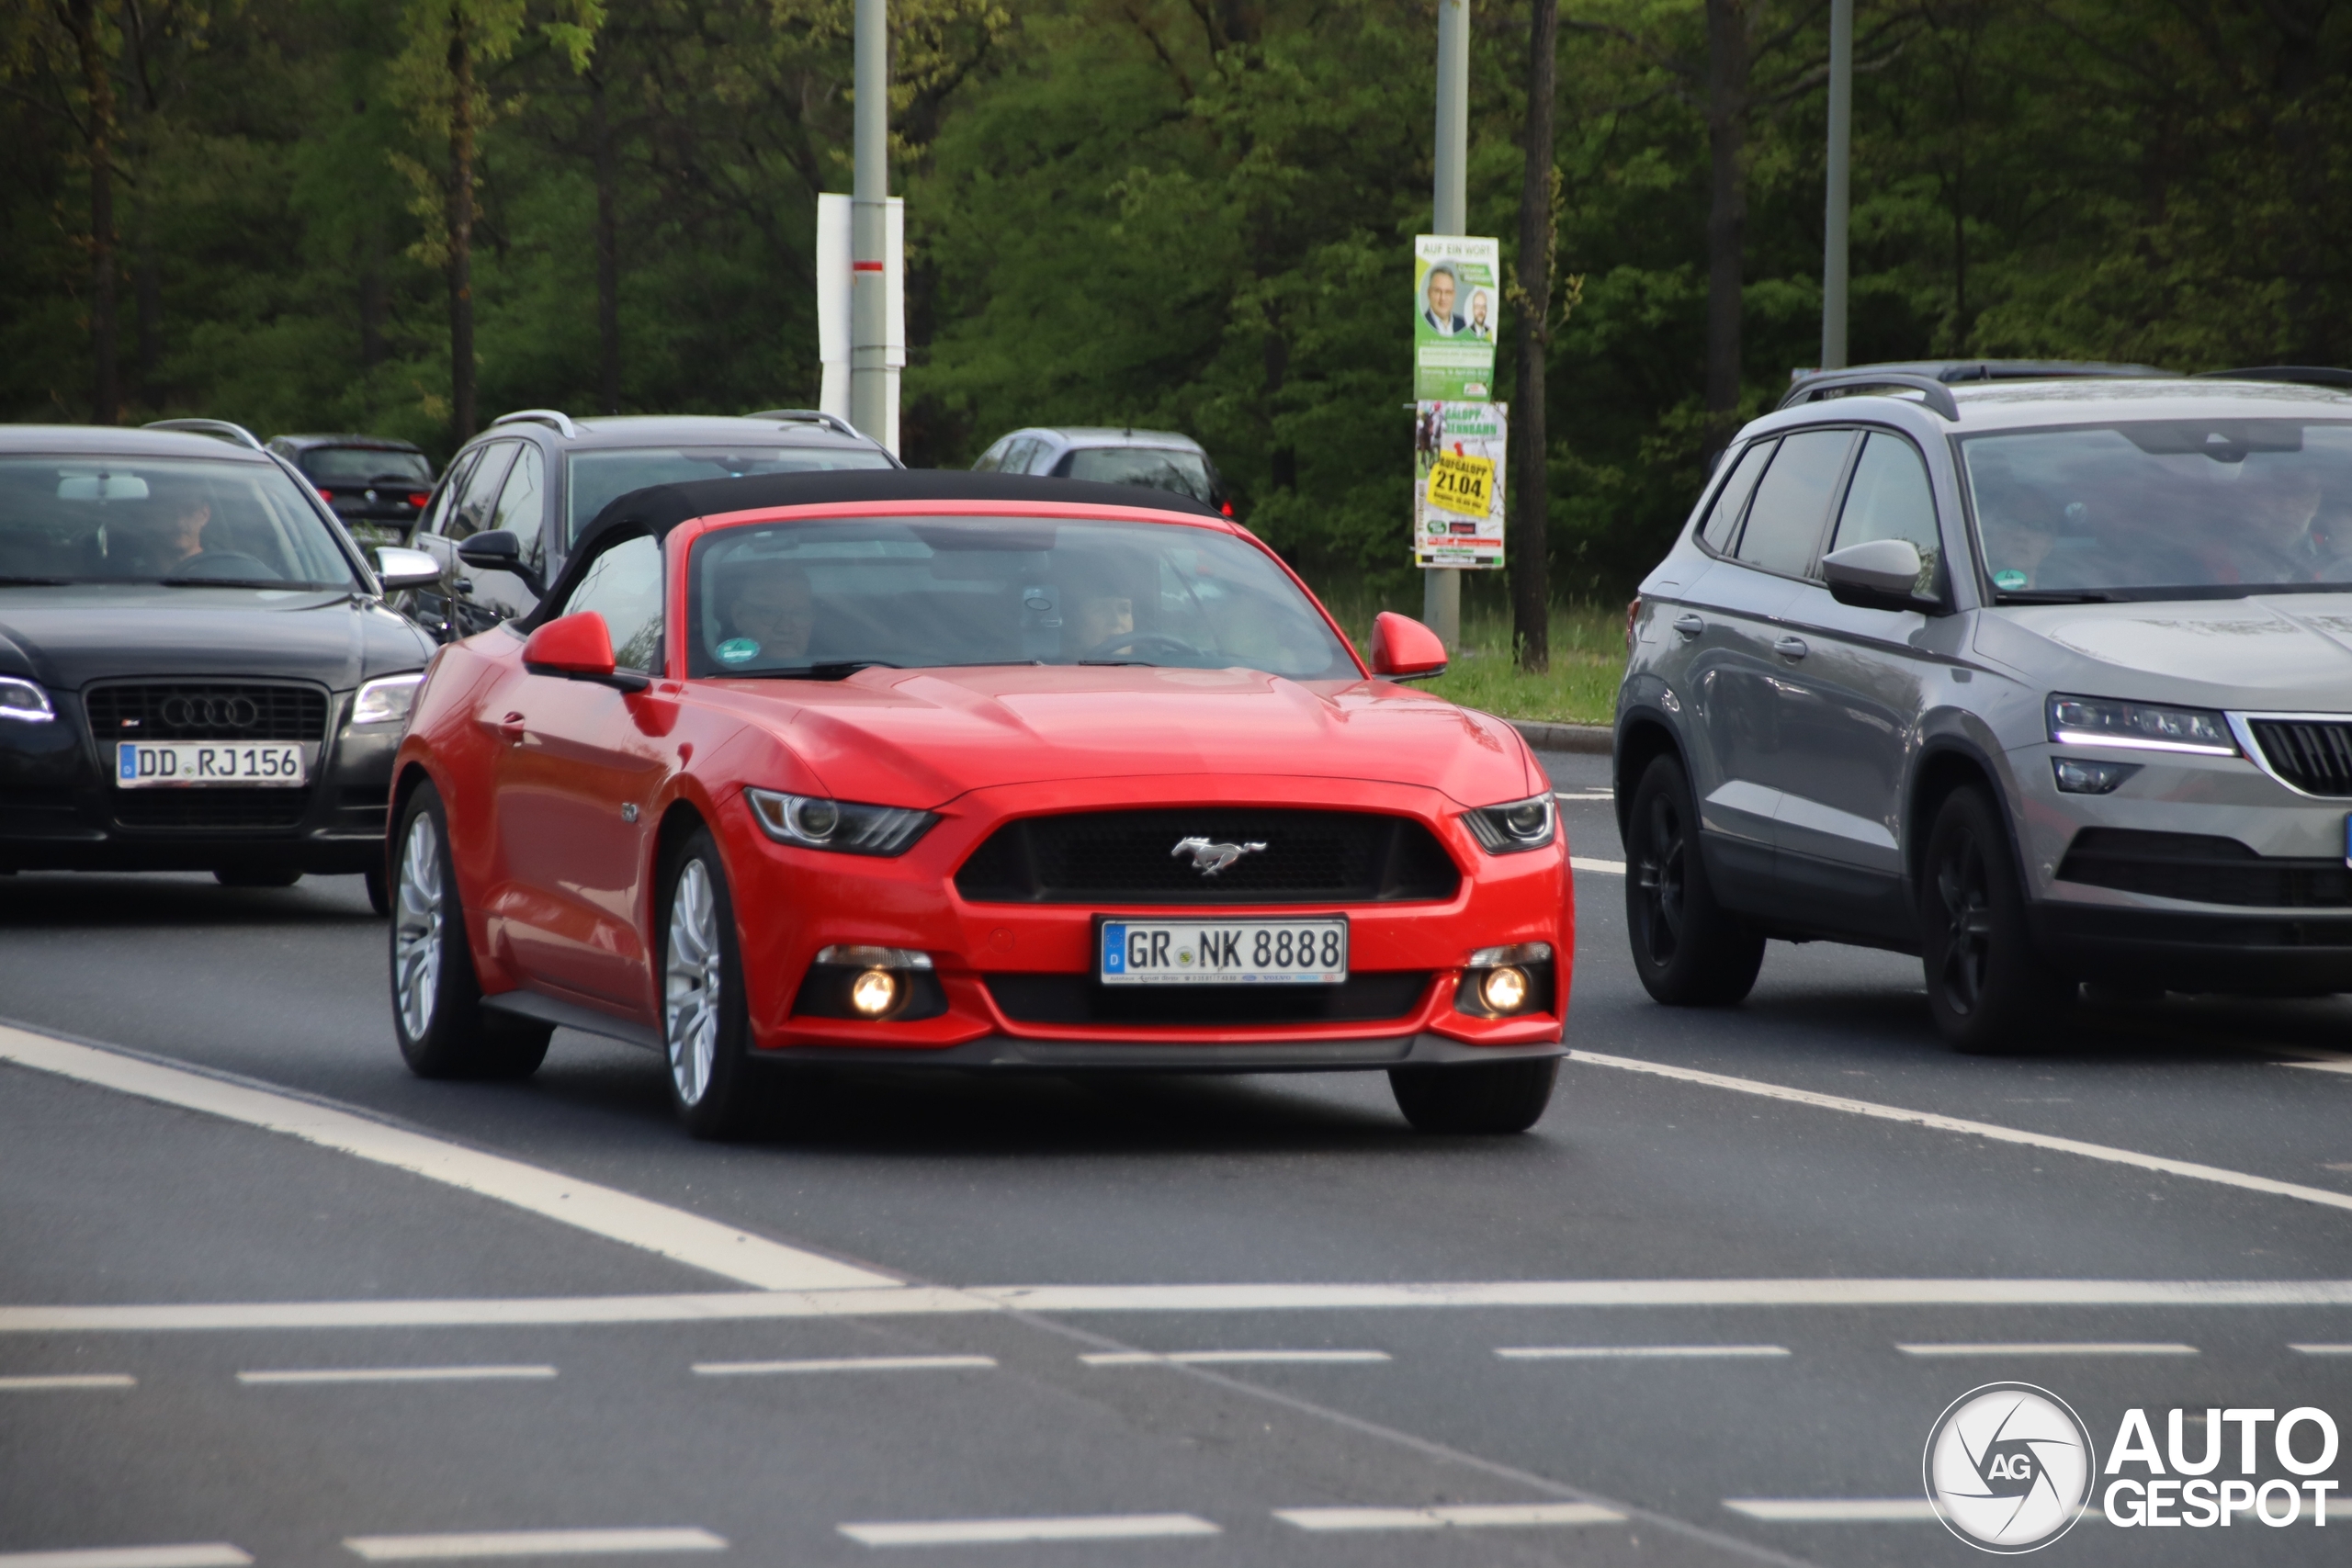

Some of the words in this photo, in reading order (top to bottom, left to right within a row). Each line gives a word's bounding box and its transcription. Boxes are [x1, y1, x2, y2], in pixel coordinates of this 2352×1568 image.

[1423, 243, 1442, 254] AUF
[1447, 243, 1462, 254] EIN
[1440, 458, 1487, 477] AUFGALOPP
[1435, 469, 1485, 499] 21.04.
[139, 749, 176, 776] DD
[198, 749, 236, 776] RJ
[243, 749, 297, 776] 156
[1110, 954, 1118, 965] D
[1127, 930, 1170, 968] GR
[1200, 930, 1243, 967] NK
[1252, 930, 1340, 968] 8888
